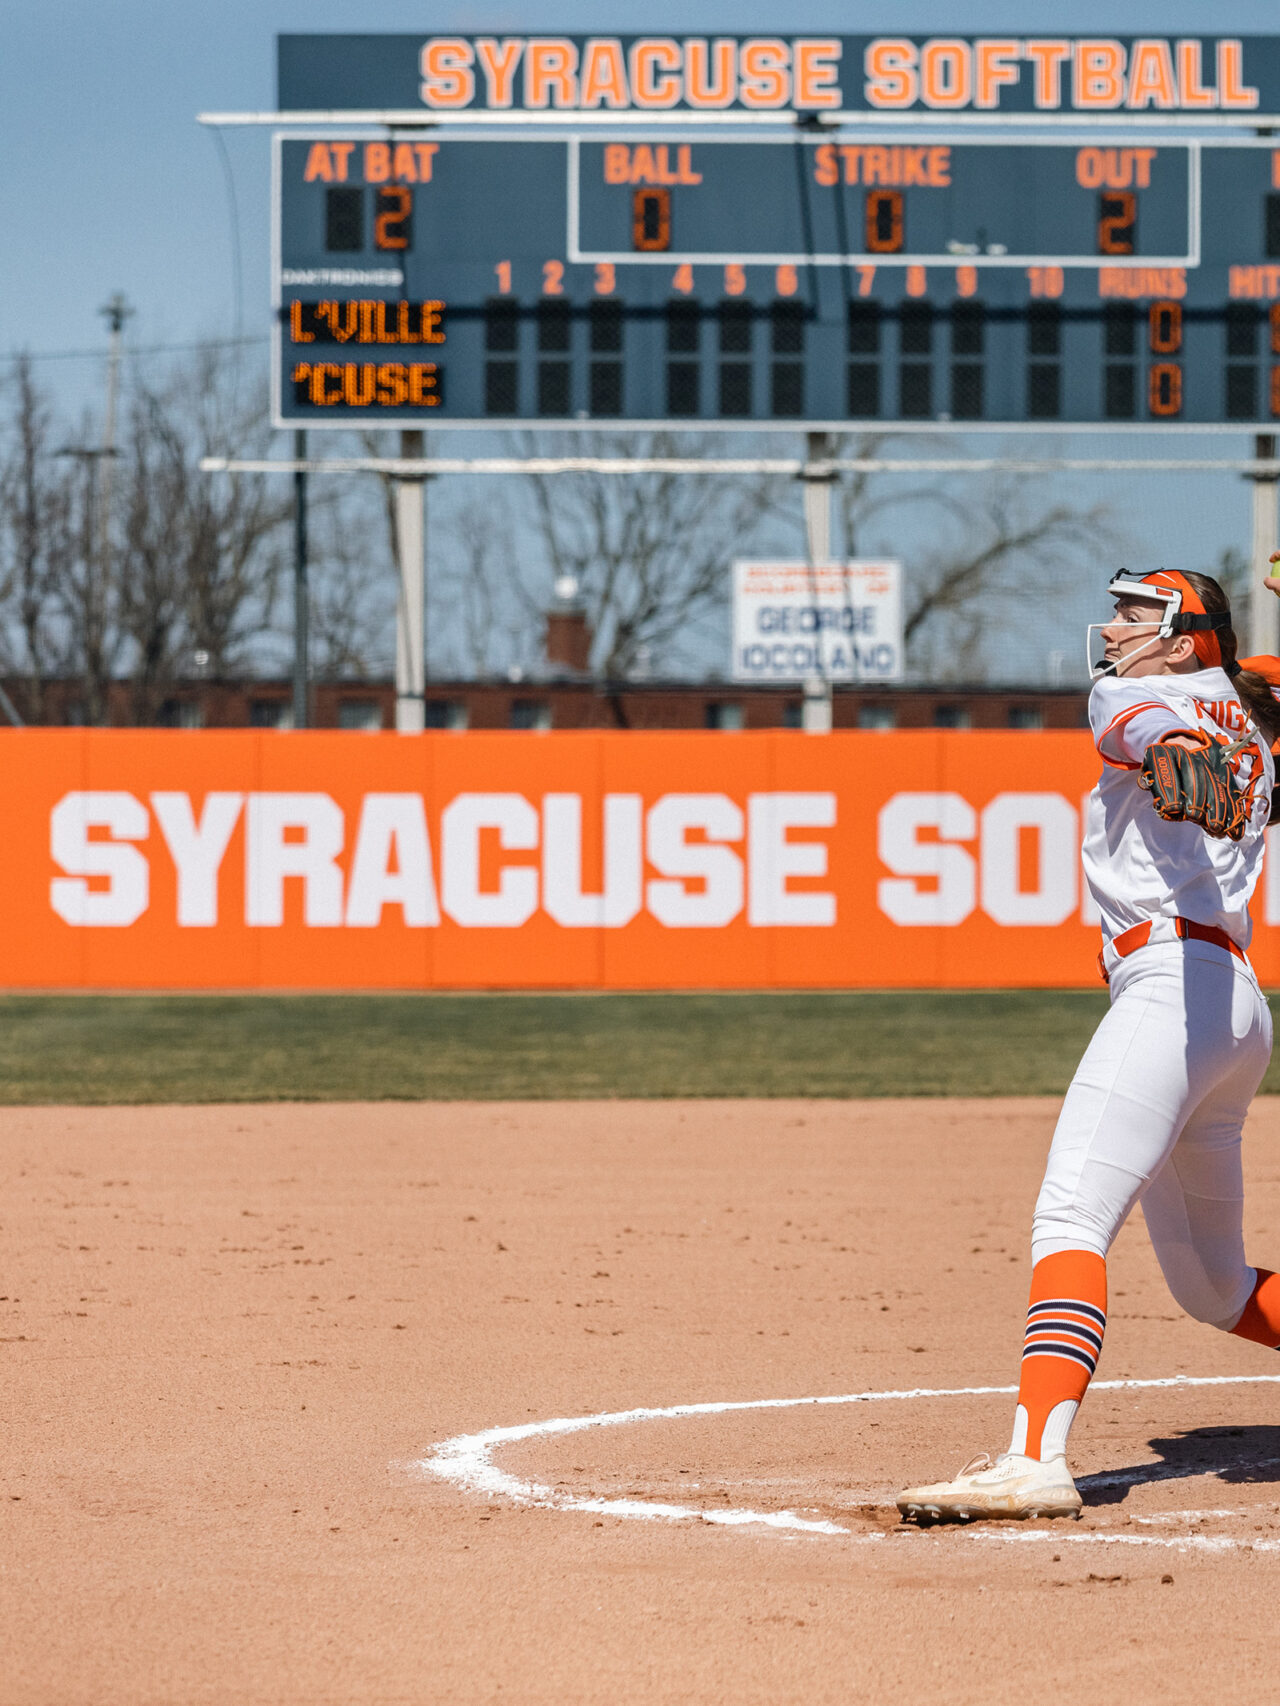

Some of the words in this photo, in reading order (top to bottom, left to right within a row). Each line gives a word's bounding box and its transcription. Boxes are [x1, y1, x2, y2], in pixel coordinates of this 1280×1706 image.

[421, 38, 842, 109] SYRACUSE
[866, 39, 1259, 109] SOFTBALL
[304, 141, 355, 183] AT
[364, 141, 440, 183] BAT
[604, 143, 702, 185] BALL
[814, 145, 951, 187] STRIKE
[1076, 147, 1157, 189] OUT
[375, 185, 411, 250] 2
[633, 187, 671, 252] 0
[865, 189, 904, 253] 0
[1098, 190, 1136, 255] 2
[496, 261, 511, 294] 1
[543, 260, 564, 295] 2
[594, 261, 616, 295] 3
[672, 263, 694, 294] 4
[724, 262, 746, 296] 5
[775, 263, 798, 296] 6
[856, 264, 877, 297] 7
[906, 264, 927, 297] 8
[956, 264, 977, 298] 9
[1027, 265, 1065, 299] 10
[1098, 265, 1187, 299] RUNS
[1149, 300, 1182, 353] 0
[1148, 363, 1182, 415] 0
[49, 790, 838, 929] SYRACUSE
